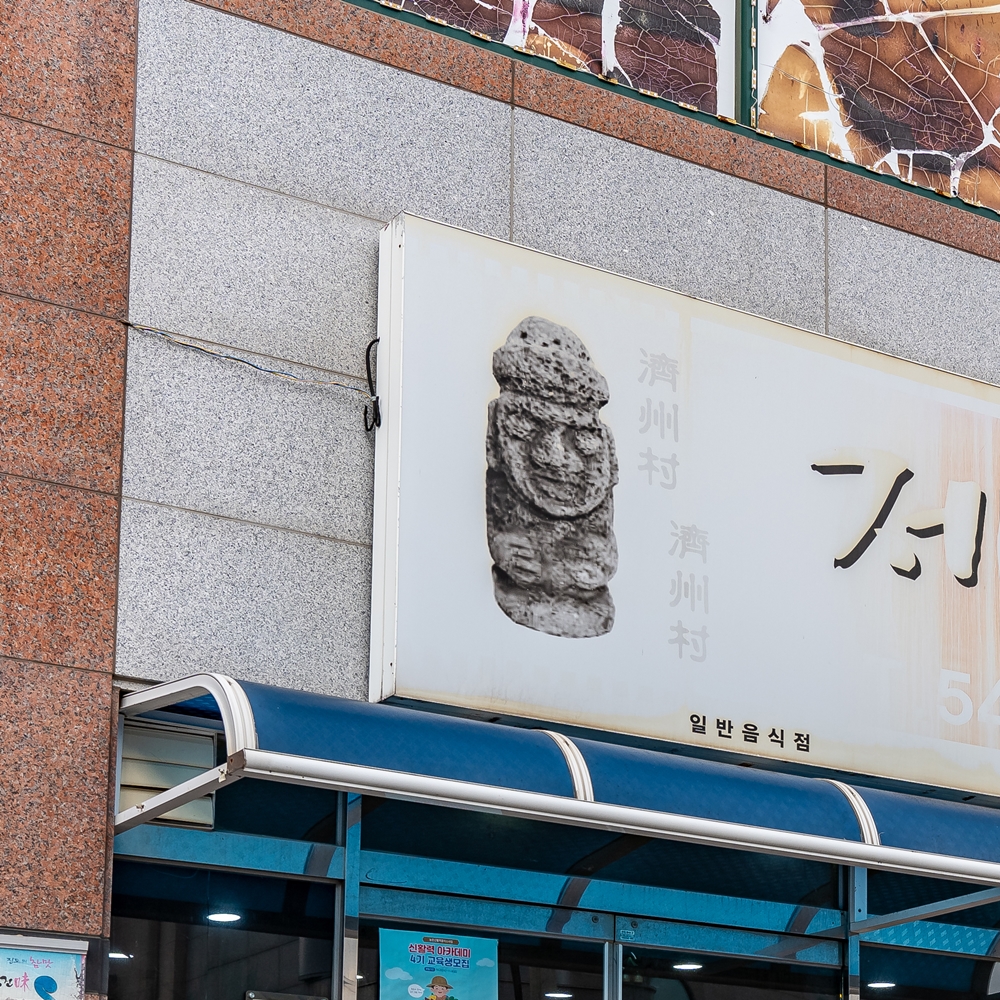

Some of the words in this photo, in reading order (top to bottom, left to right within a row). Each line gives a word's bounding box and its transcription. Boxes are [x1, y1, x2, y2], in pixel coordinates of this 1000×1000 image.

[688, 712, 811, 754] 일반음식점
[408, 943, 435, 955] 신활력
[437, 946, 471, 958] 아카데미
[409, 954, 425, 964] 4기
[427, 956, 470, 969] 교육생모집
